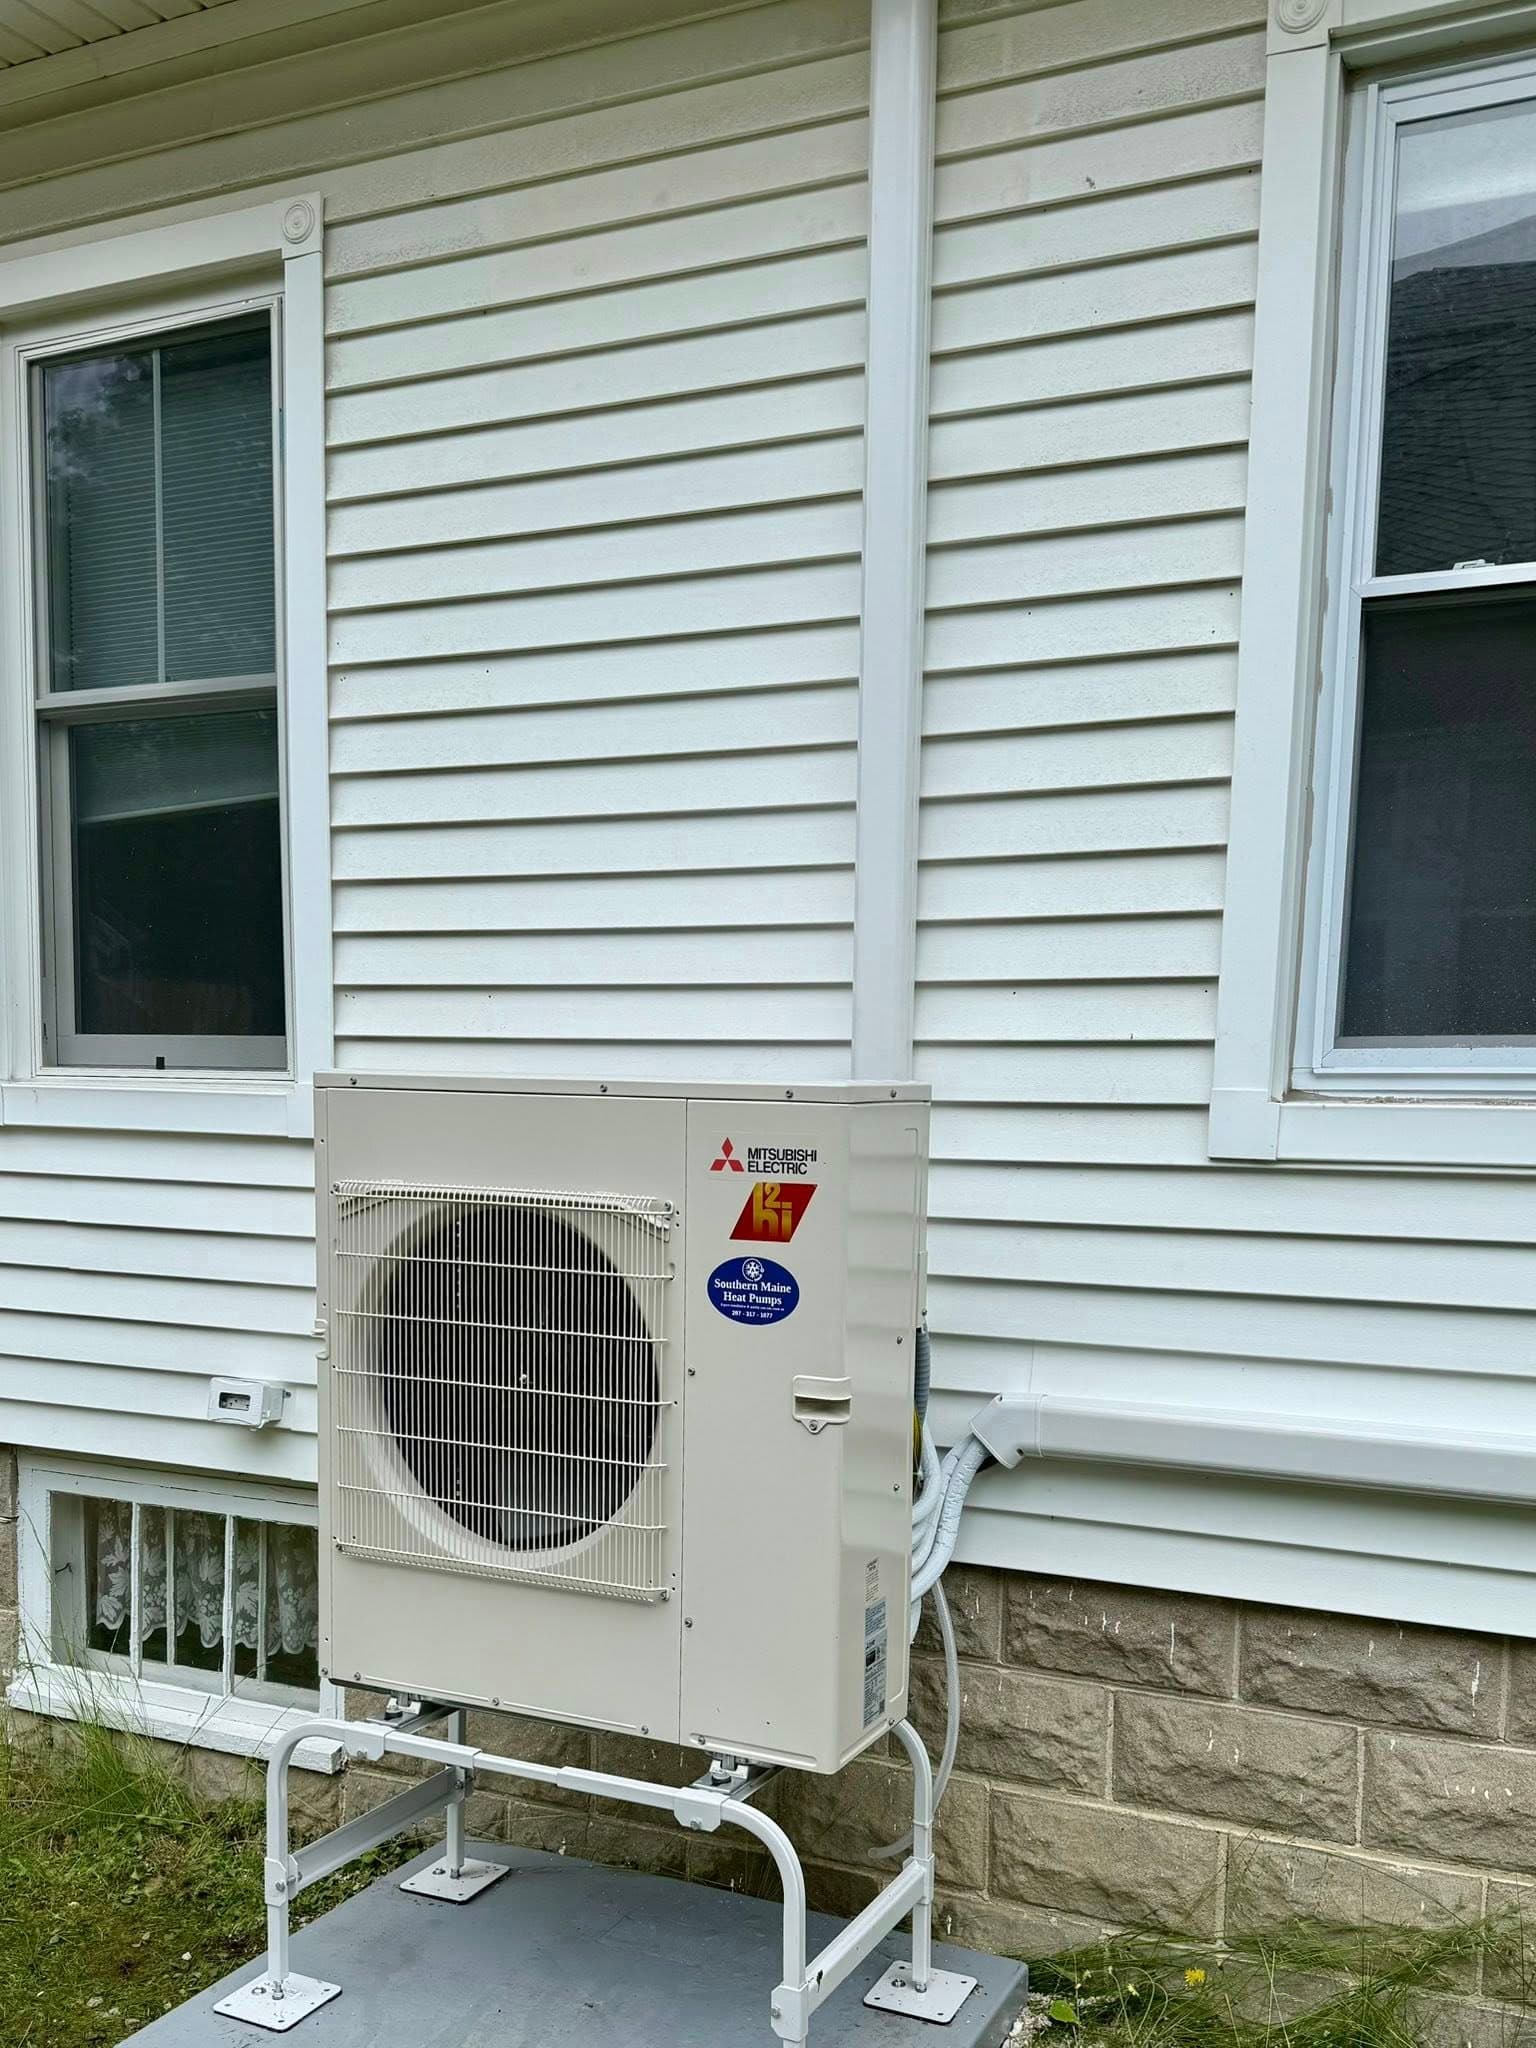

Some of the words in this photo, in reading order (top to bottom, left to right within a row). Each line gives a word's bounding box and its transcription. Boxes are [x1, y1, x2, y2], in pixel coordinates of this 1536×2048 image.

[748, 1148, 817, 1162] MITSUBISHI
[748, 1162, 807, 1175] ELECTRIC
[714, 1278, 758, 1291] Southern
[761, 1281, 792, 1294] Maine
[723, 1291, 747, 1303] Heat
[749, 1293, 782, 1307] Pumps
